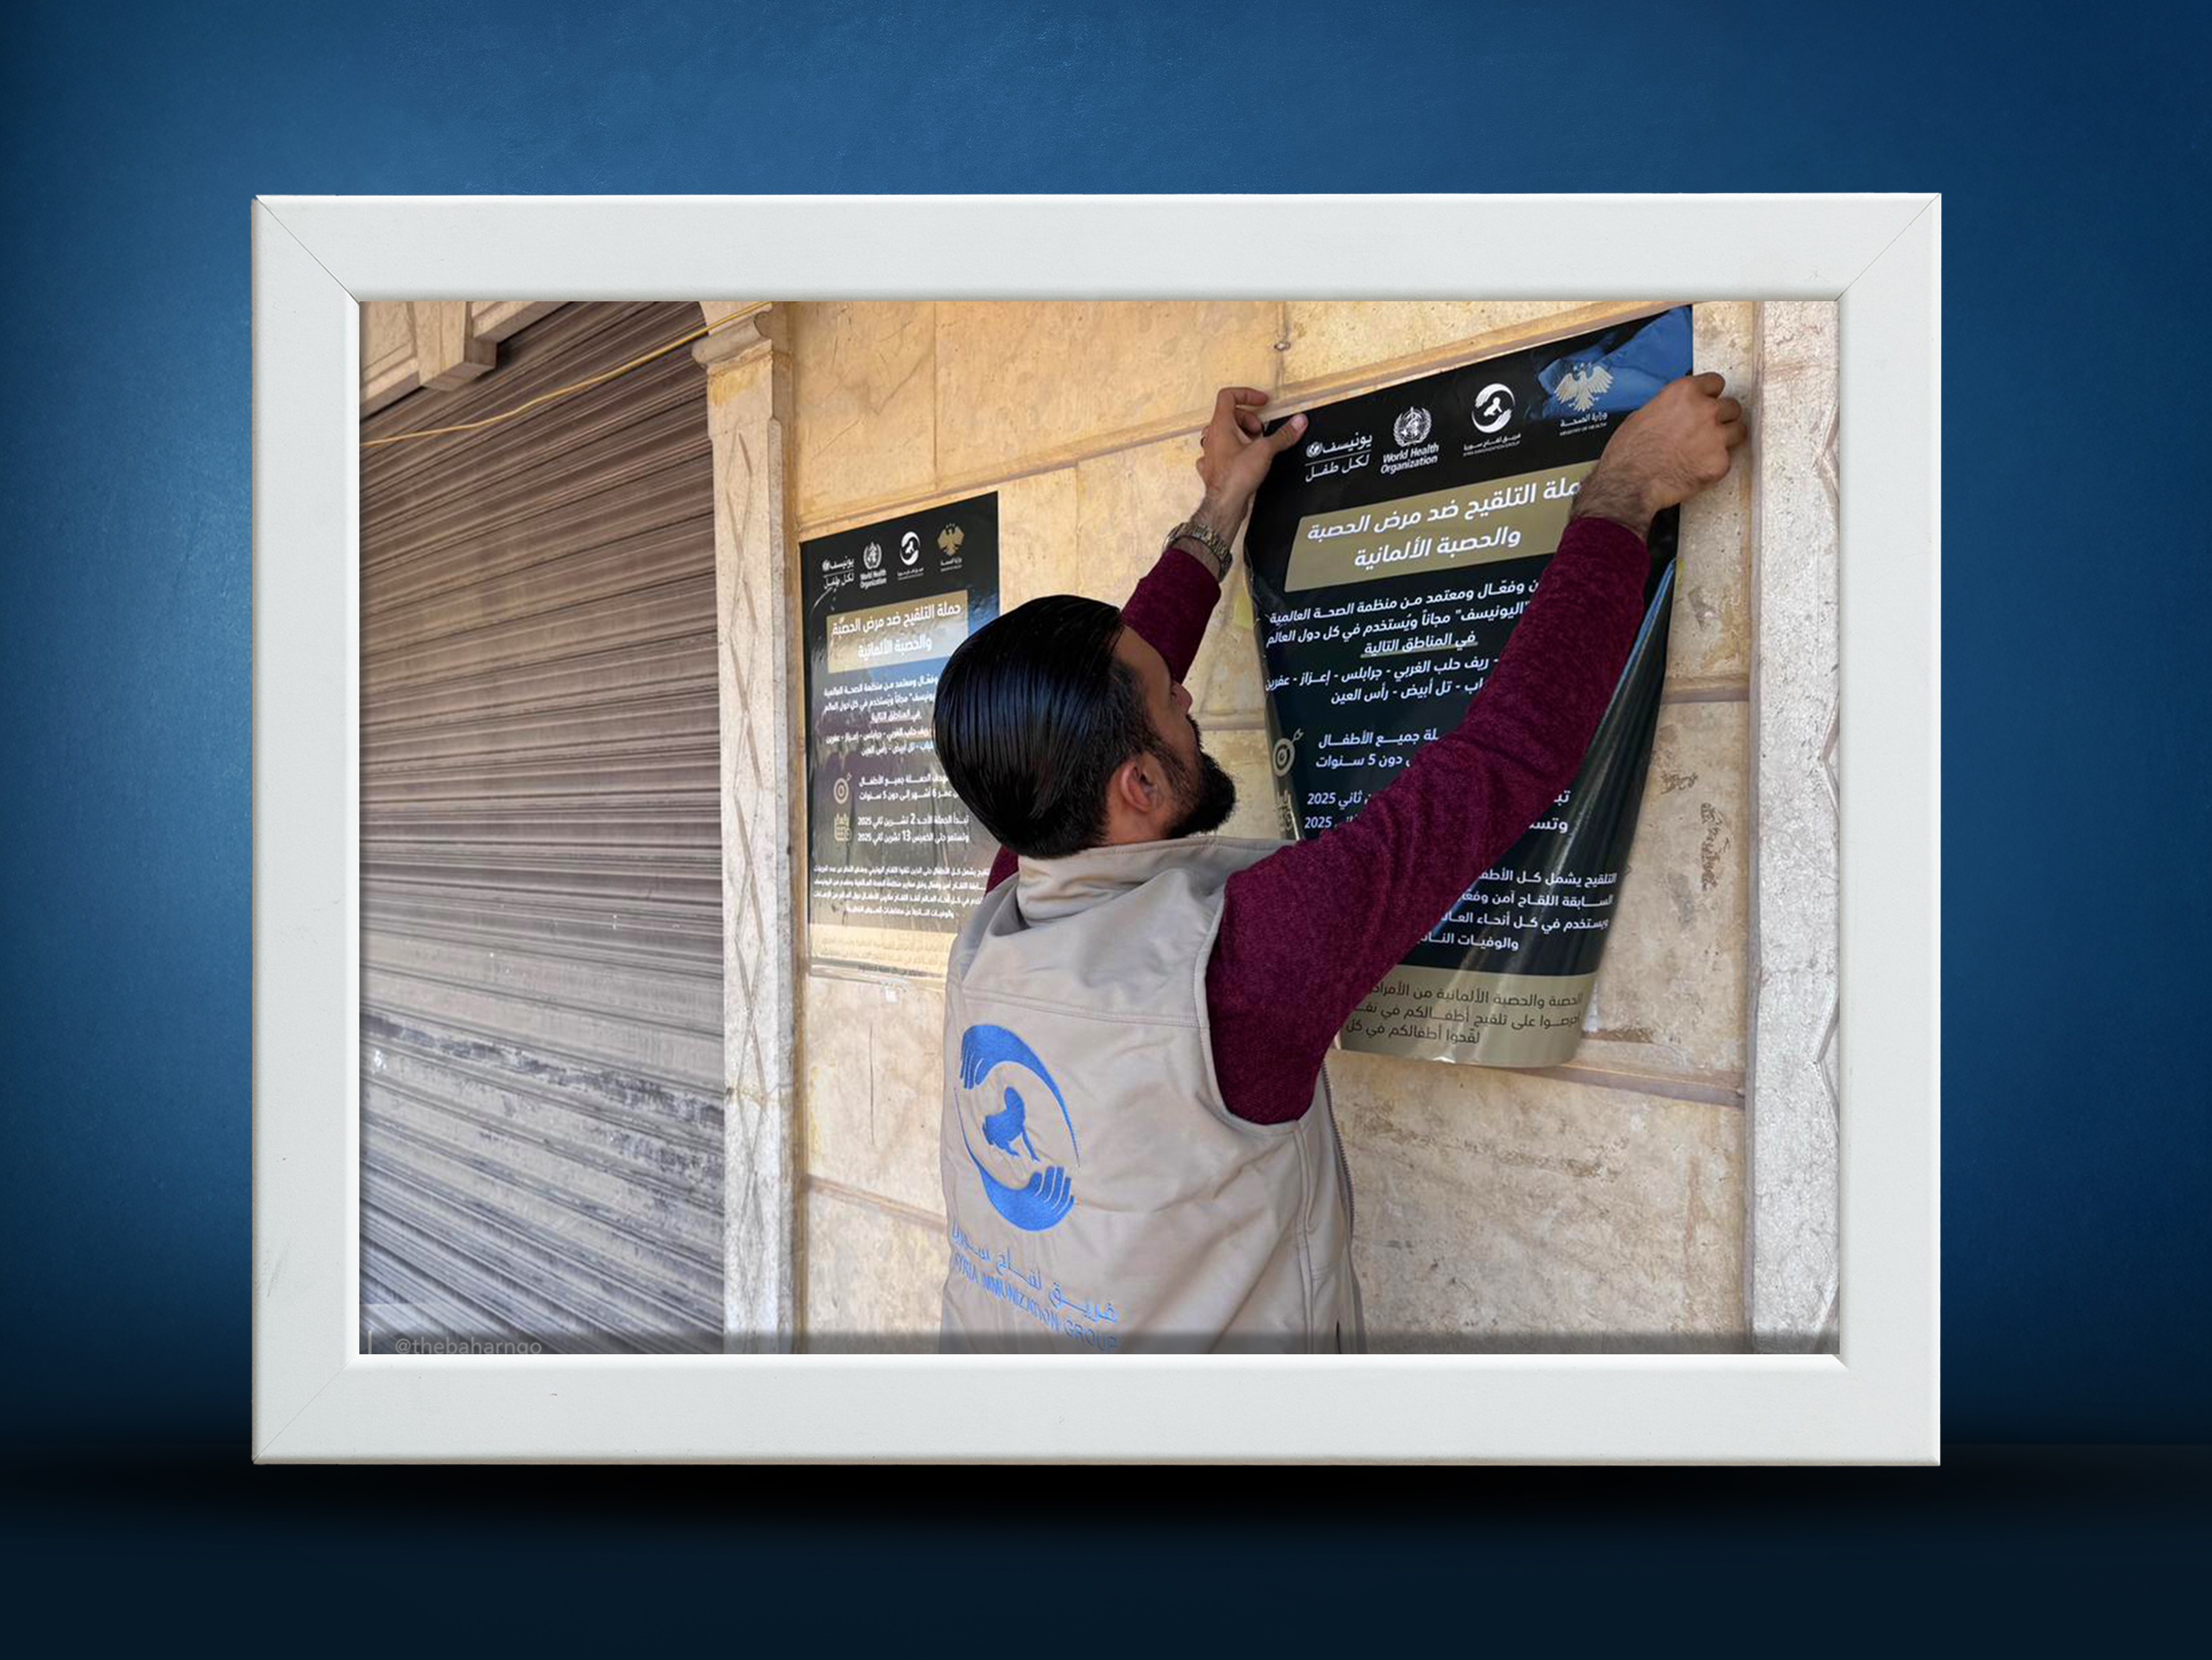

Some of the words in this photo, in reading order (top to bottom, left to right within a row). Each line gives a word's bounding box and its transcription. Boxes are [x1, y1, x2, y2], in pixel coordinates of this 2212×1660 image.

[1323, 432, 1373, 454] يونيسف
[1382, 448, 1409, 464] World
[1410, 442, 1439, 457] Health
[1341, 453, 1370, 474] لكل
[1380, 455, 1439, 474] Organization
[1543, 477, 1581, 499] ملة
[1427, 500, 1459, 522] ضد
[1463, 484, 1537, 521] التلقيح
[1307, 514, 1371, 543] الحصبة
[1373, 511, 1422, 534] مرض
[1436, 526, 1522, 559] والحصبة
[1353, 537, 1432, 571] الألمانية
[1356, 597, 1398, 614] منظمة
[1400, 595, 1423, 610] من
[1425, 588, 1474, 606] ومعتمد
[903, 604, 935, 628] التلقيح
[937, 601, 962, 617] حملة
[1269, 608, 1311, 627] العالمية
[1312, 602, 1355, 620] الصحة
[863, 615, 885, 633] مرض
[886, 611, 901, 626] ضد
[832, 618, 861, 637] الحصبة
[1297, 628, 1321, 643] دول
[1321, 626, 1341, 642] كل
[1341, 623, 1361, 641] في
[894, 634, 933, 656] والحصبة
[1265, 630, 1297, 648] العالم
[1363, 638, 1400, 656] التالية
[1401, 633, 1453, 652] المناطق
[1455, 633, 1477, 650] في
[1393, 660, 1431, 680] الغربي
[1433, 657, 1461, 674] حلب
[1463, 656, 1490, 671] ريف
[1299, 670, 1332, 686] إعزاز
[1341, 666, 1383, 684] جرابلس
[1364, 683, 1390, 702] رأس
[1400, 677, 1434, 699] أبيض
[1435, 679, 1452, 696] تل
[1330, 689, 1362, 705] العين
[1318, 729, 1374, 748] الأطفال
[1375, 731, 1420, 747] جميع
[1315, 754, 1365, 769] سنوات
[1368, 753, 1376, 766] 5
[1378, 755, 1402, 768] دون
[1307, 792, 1336, 805] 2025
[1338, 790, 1363, 810] ثاني
[910, 813, 915, 825] 2
[1304, 816, 1333, 829] 2025
[902, 829, 912, 841] 13
[1516, 870, 1542, 884] كل
[1544, 872, 1582, 887] يشمل
[1518, 894, 1559, 908] اللقاح
[1477, 911, 1510, 926] أنحاء
[1513, 915, 1538, 930] كل
[1541, 918, 1561, 934] في
[1457, 934, 1520, 951] والوفيات
[1413, 989, 1433, 1000] من
[1436, 988, 1489, 1004] الألمانية
[1493, 993, 1544, 1009] والحصبة
[1381, 1004, 1401, 1018] في
[1404, 1006, 1469, 1024] أطفالكم
[1346, 1019, 1363, 1033] كل
[1473, 1014, 1508, 1031] تلقيح
[1511, 1014, 1536, 1030] على
[1366, 1025, 1386, 1039] في
[1388, 1024, 1442, 1041] أطفالكم
